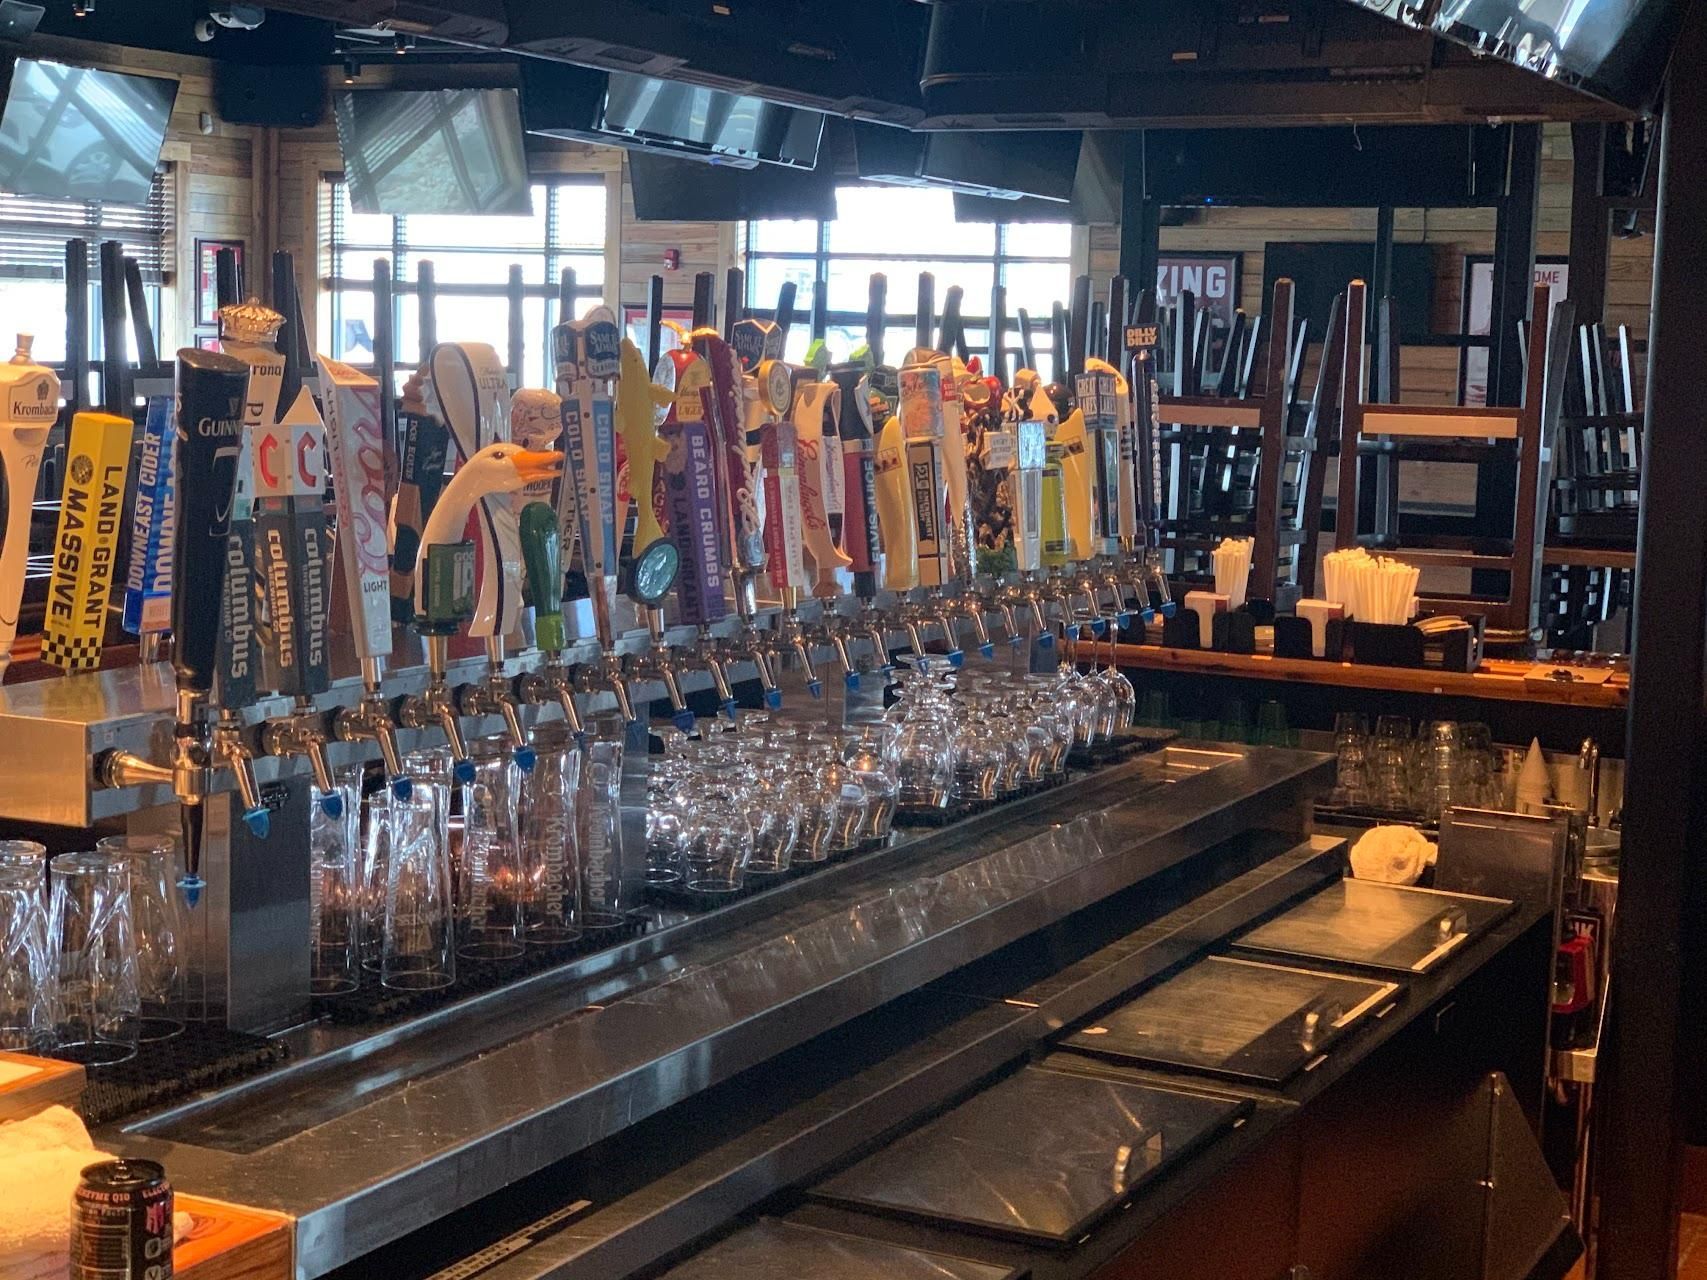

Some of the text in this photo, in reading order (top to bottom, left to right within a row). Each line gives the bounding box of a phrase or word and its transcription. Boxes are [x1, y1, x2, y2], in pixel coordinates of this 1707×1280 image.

[1127, 327, 1157, 338] DILLY
[1127, 336, 1157, 347] DILLY
[565, 409, 583, 461] COLD
[1078, 377, 1097, 397] GREAT
[127, 432, 161, 592] DOWNEAST CIDER
[597, 412, 613, 524] COLD SNAP
[691, 435, 719, 588] BEARD CRUMBS
[51, 487, 88, 620] MASSIVE
[267, 529, 294, 668] columbus
[305, 528, 326, 667] columbus
[363, 581, 388, 593] LIGHT
[545, 815, 570, 920] Krombacher
[112, 1192, 131, 1204] Q10
